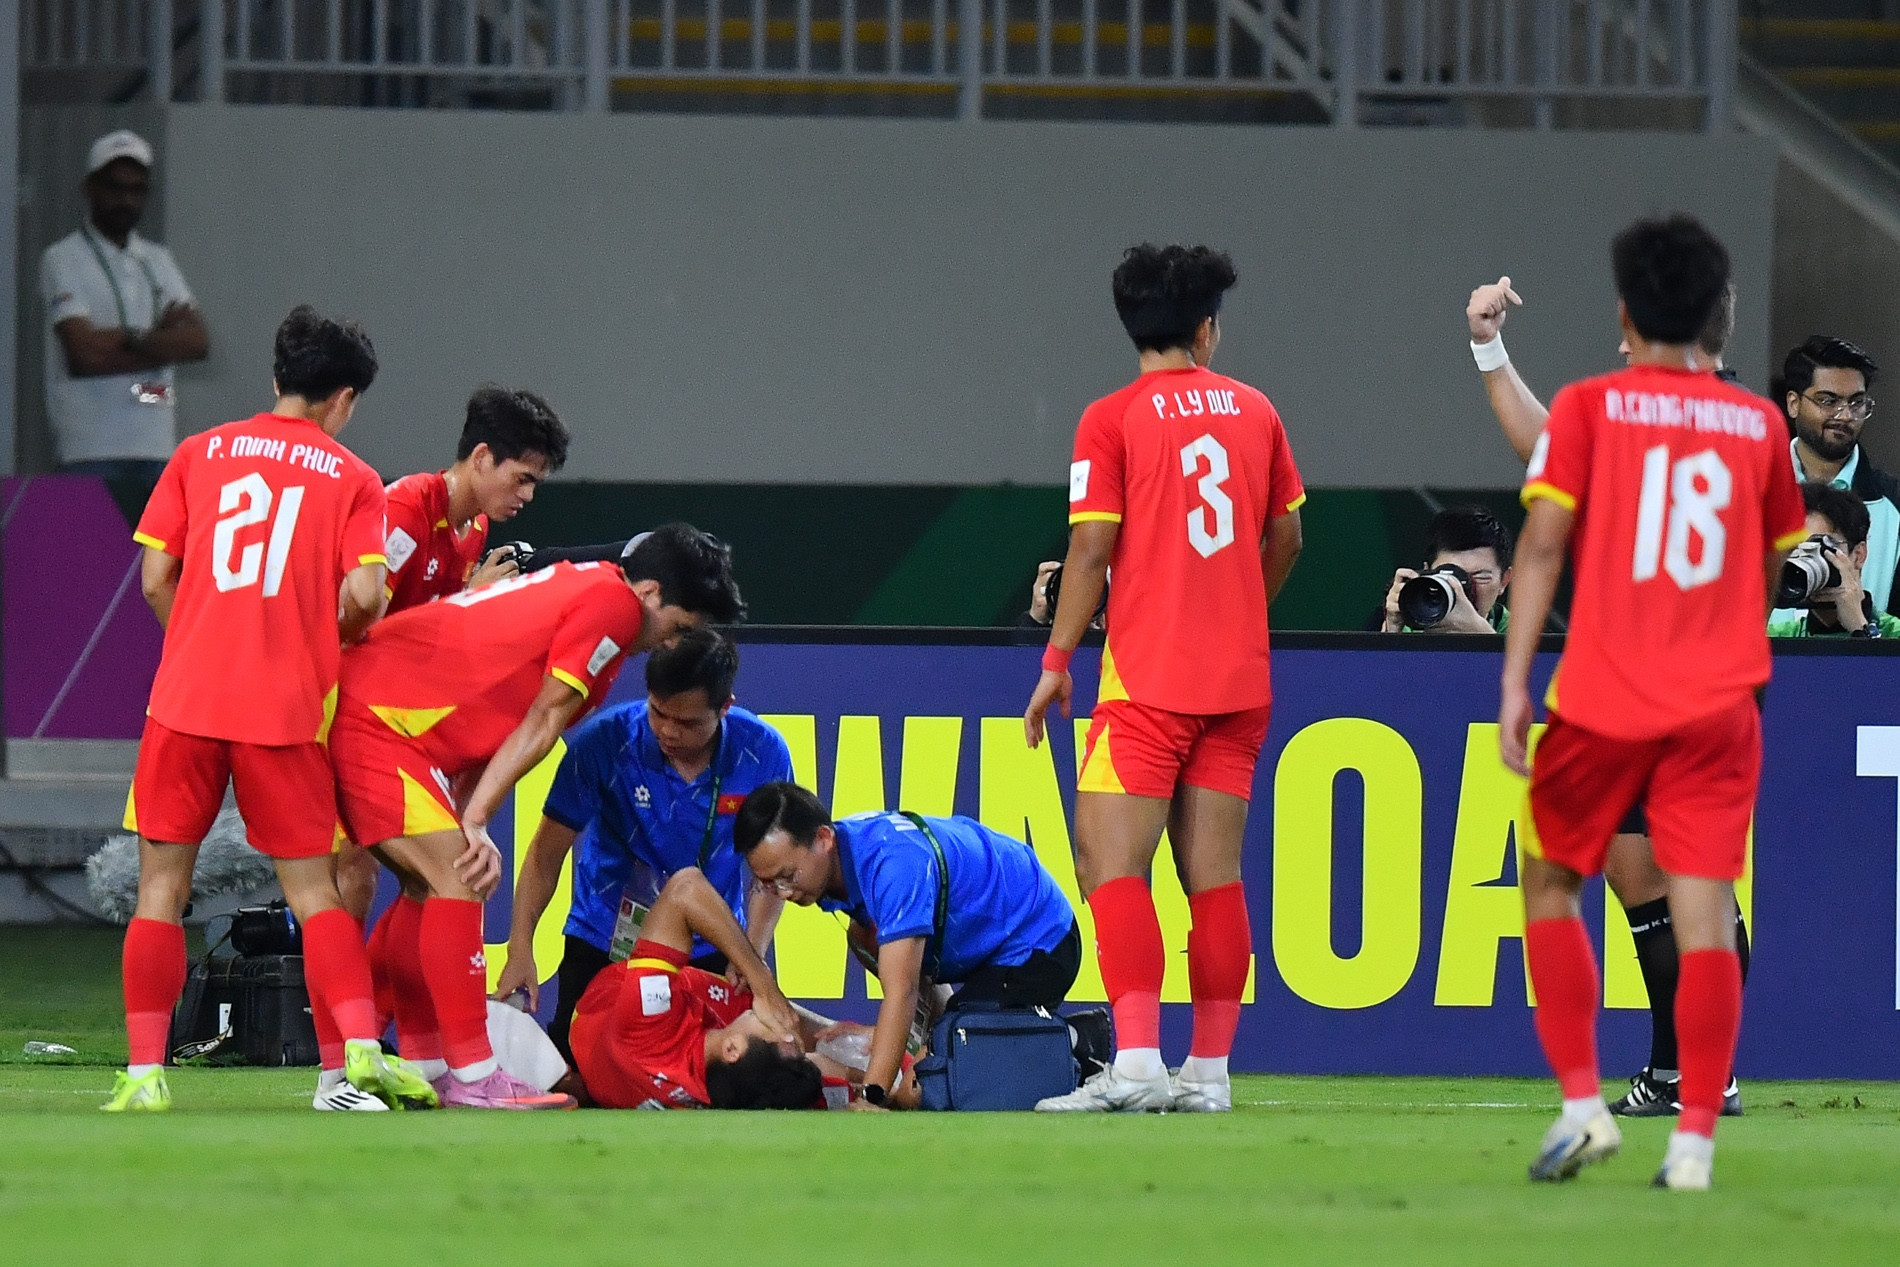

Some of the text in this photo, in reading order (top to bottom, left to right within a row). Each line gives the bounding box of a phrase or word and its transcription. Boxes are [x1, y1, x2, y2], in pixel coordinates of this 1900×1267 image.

[207, 435, 344, 479] P. MINH PHUC
[1152, 389, 1241, 419] P. LY DUC
[212, 472, 306, 598] 21
[1179, 433, 1235, 559] 3
[1632, 444, 1733, 591] 18
